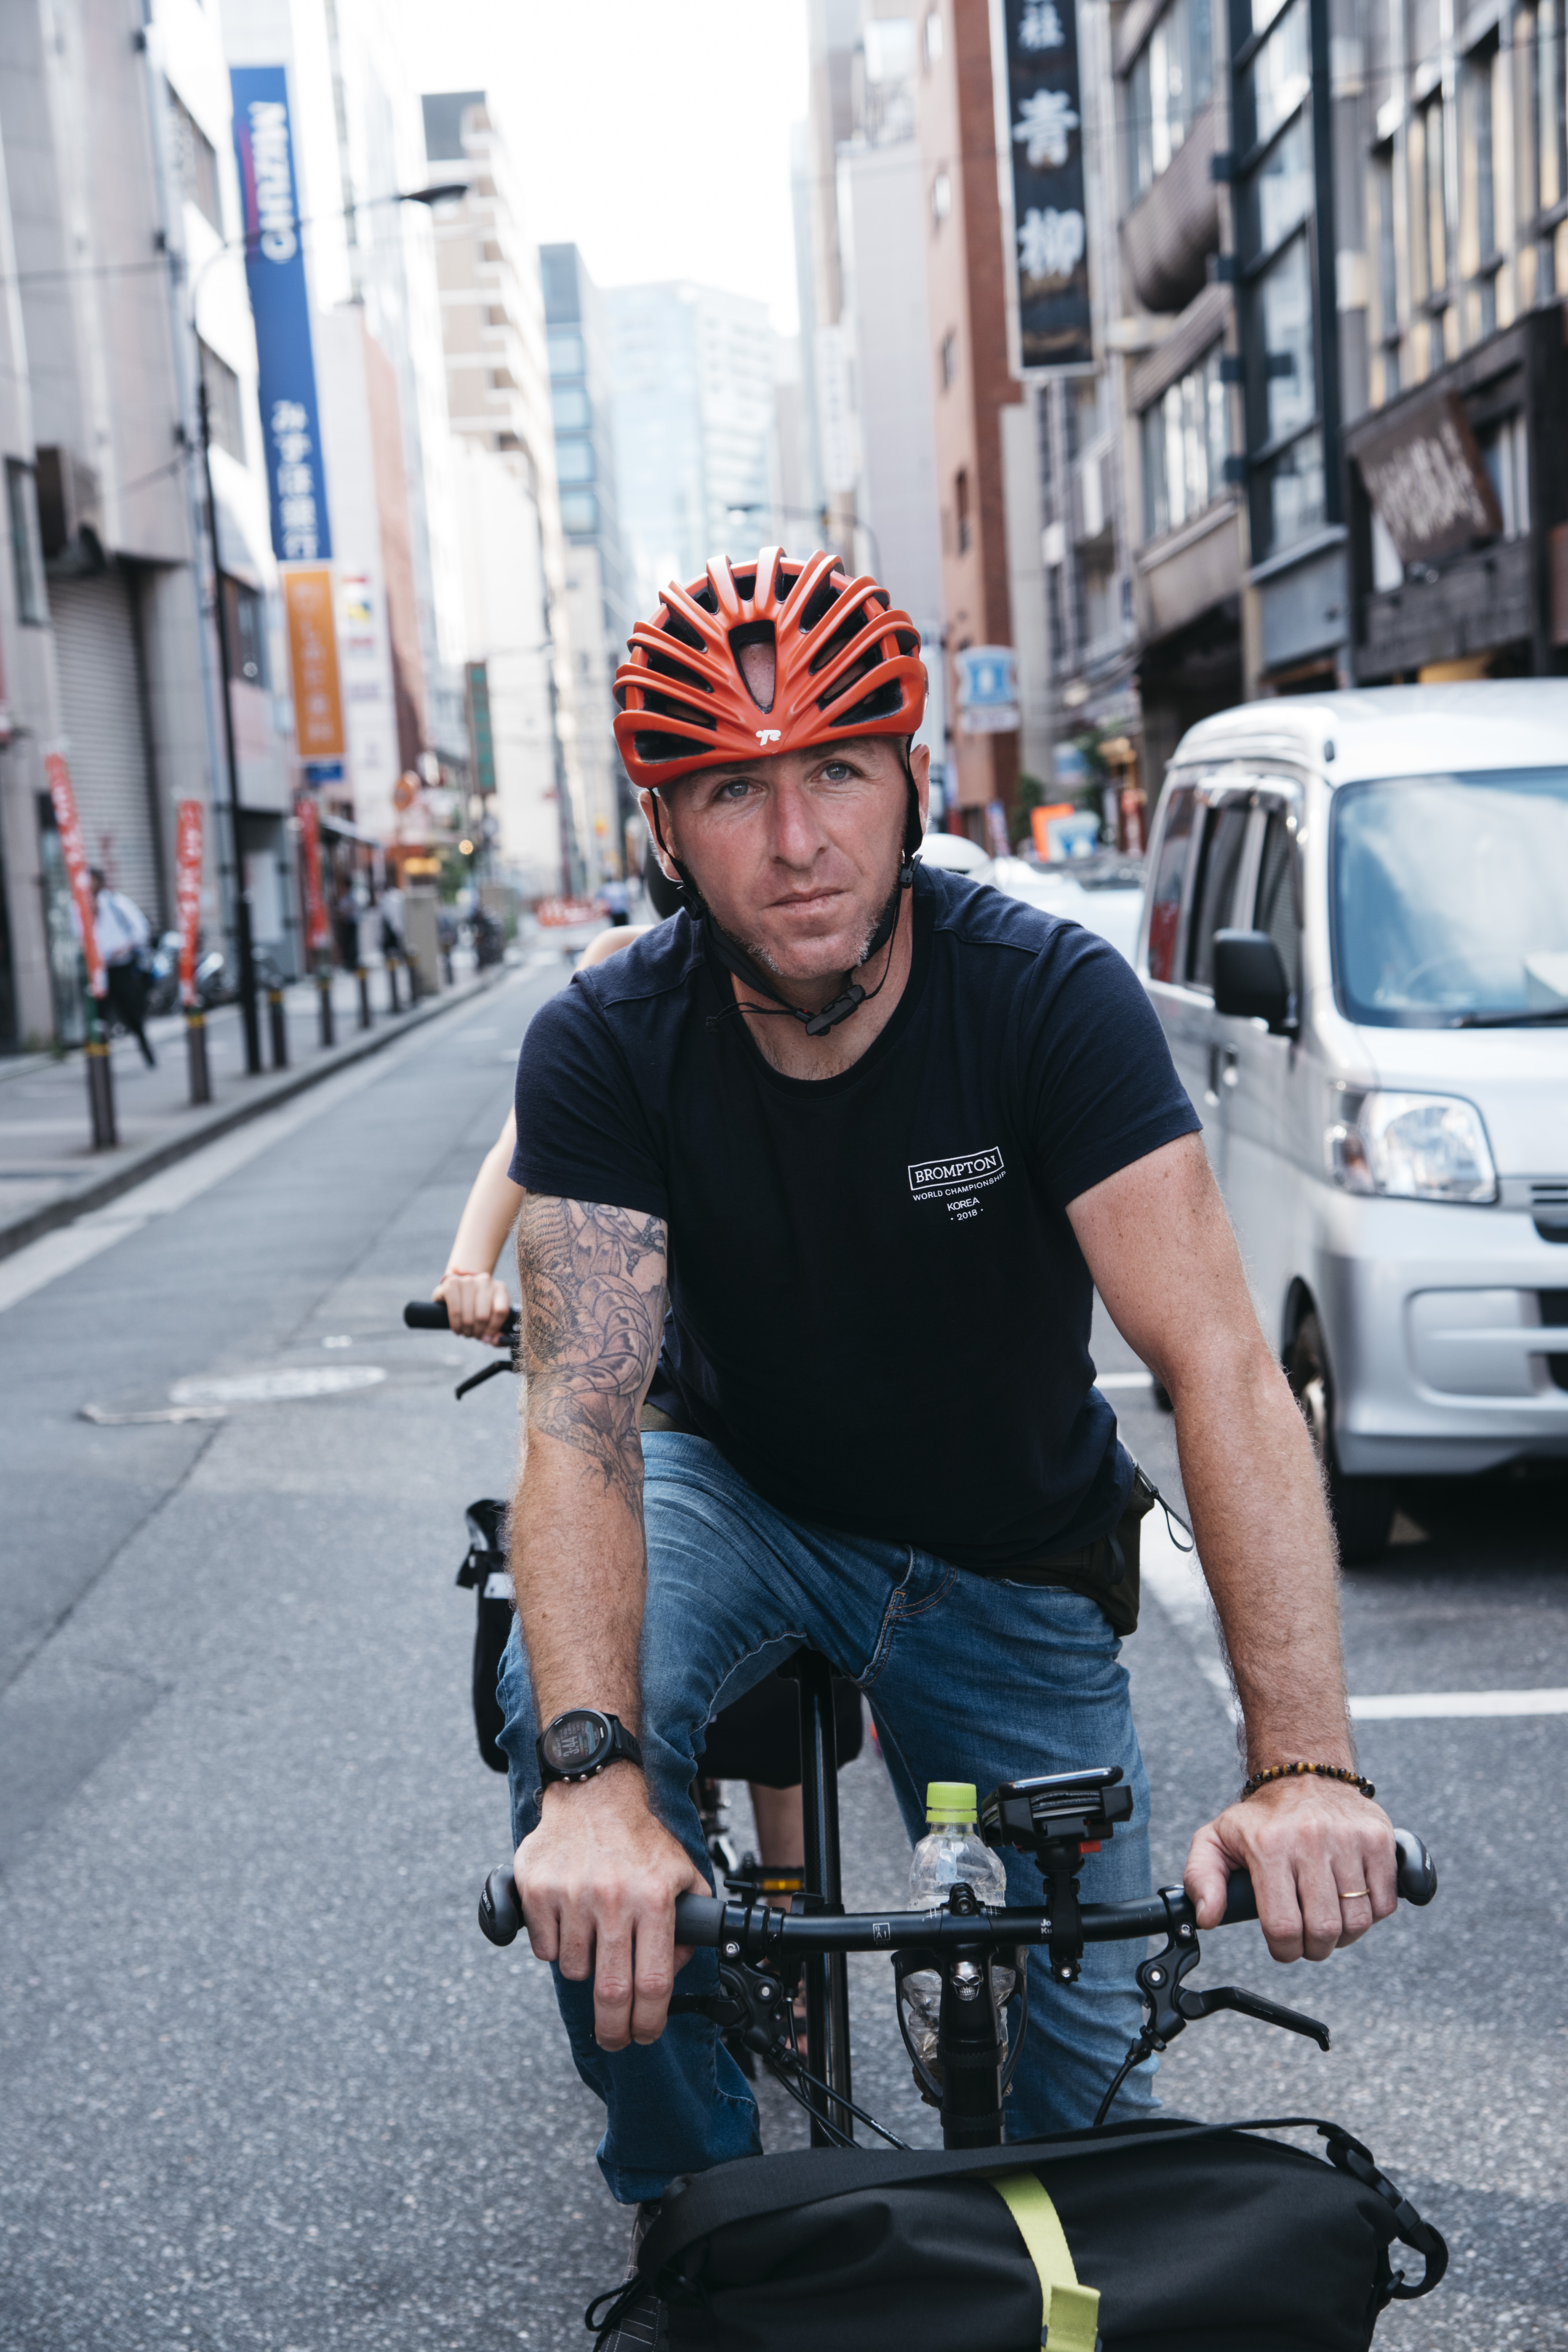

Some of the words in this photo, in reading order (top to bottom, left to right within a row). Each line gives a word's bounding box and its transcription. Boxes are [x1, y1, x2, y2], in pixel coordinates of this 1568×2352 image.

[915, 1156, 997, 1183] BROMPTON
[913, 1190, 943, 1201] WORLD
[945, 1171, 1006, 1196] CHAMPIONSHIP
[947, 1197, 980, 1211] KOREA
[957, 1209, 978, 1220] 2018
[561, 1736, 580, 1757] 3:44
